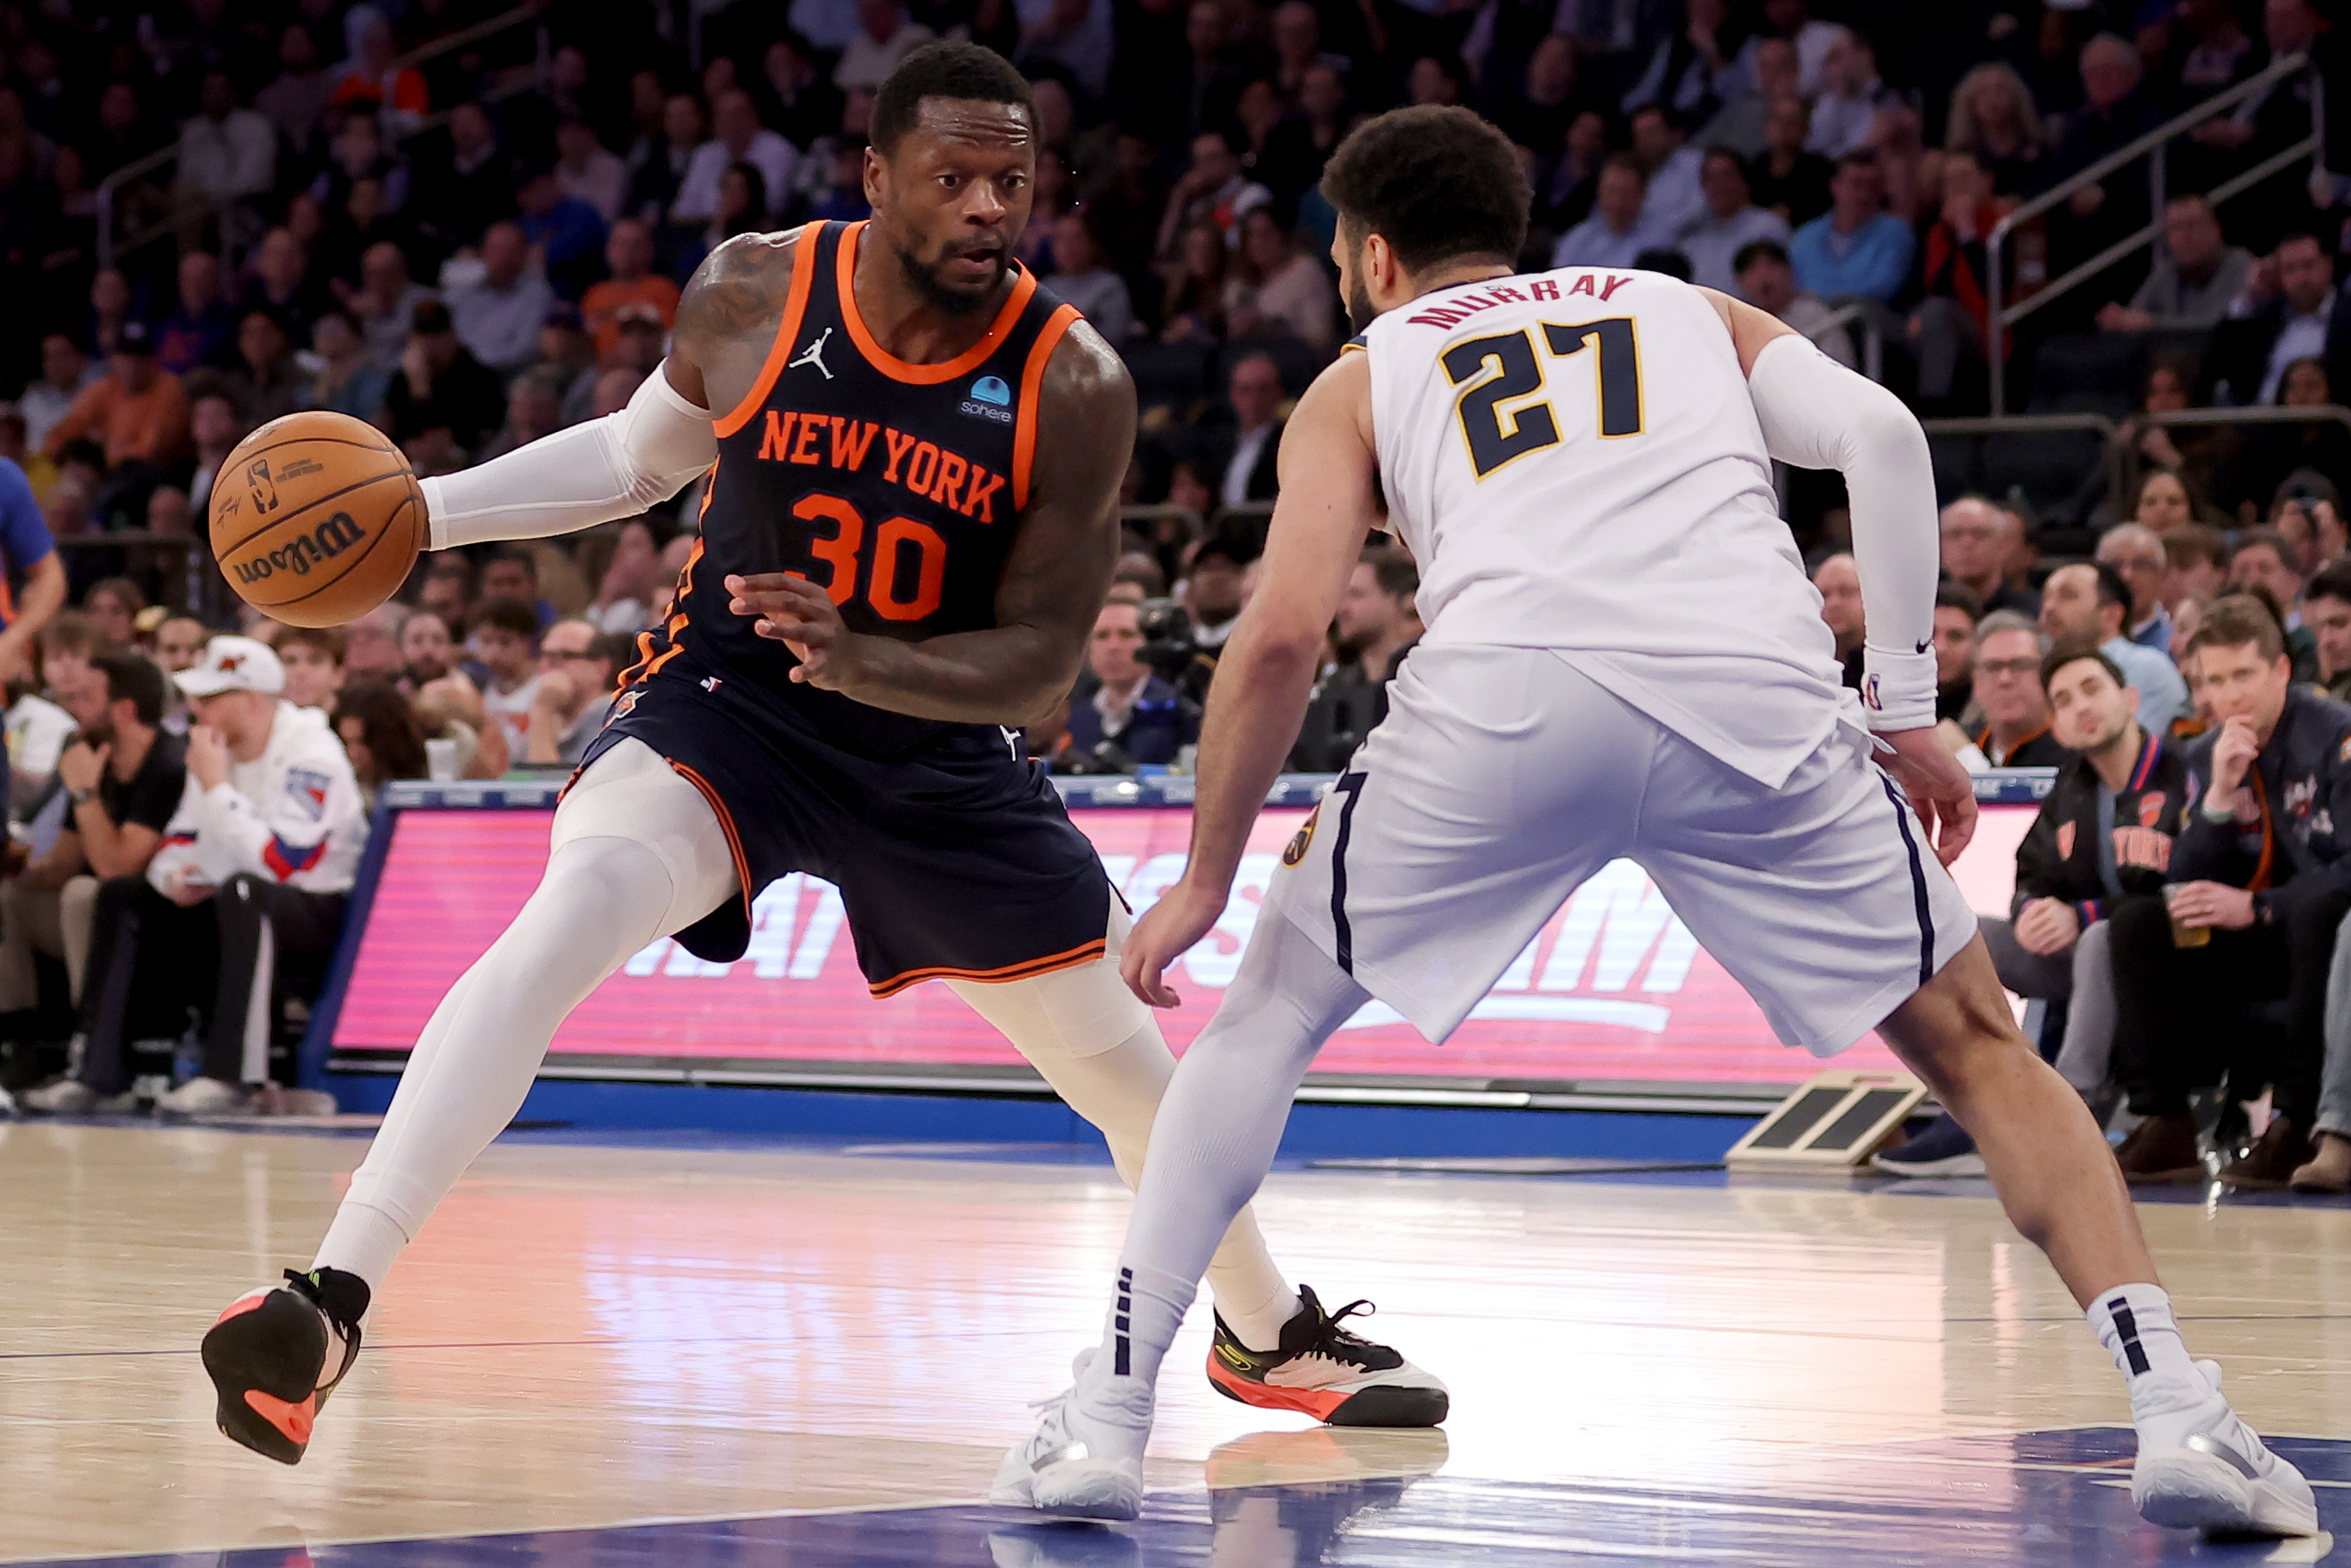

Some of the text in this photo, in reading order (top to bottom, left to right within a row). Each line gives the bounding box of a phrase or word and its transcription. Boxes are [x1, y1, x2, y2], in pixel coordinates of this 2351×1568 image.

[1407, 275, 1634, 330] MURRAY
[960, 400, 1011, 423] sphere
[1437, 316, 1646, 484] 27
[758, 409, 1005, 524] NEW YORK
[232, 511, 367, 584] Wilson
[784, 493, 947, 621] 30
